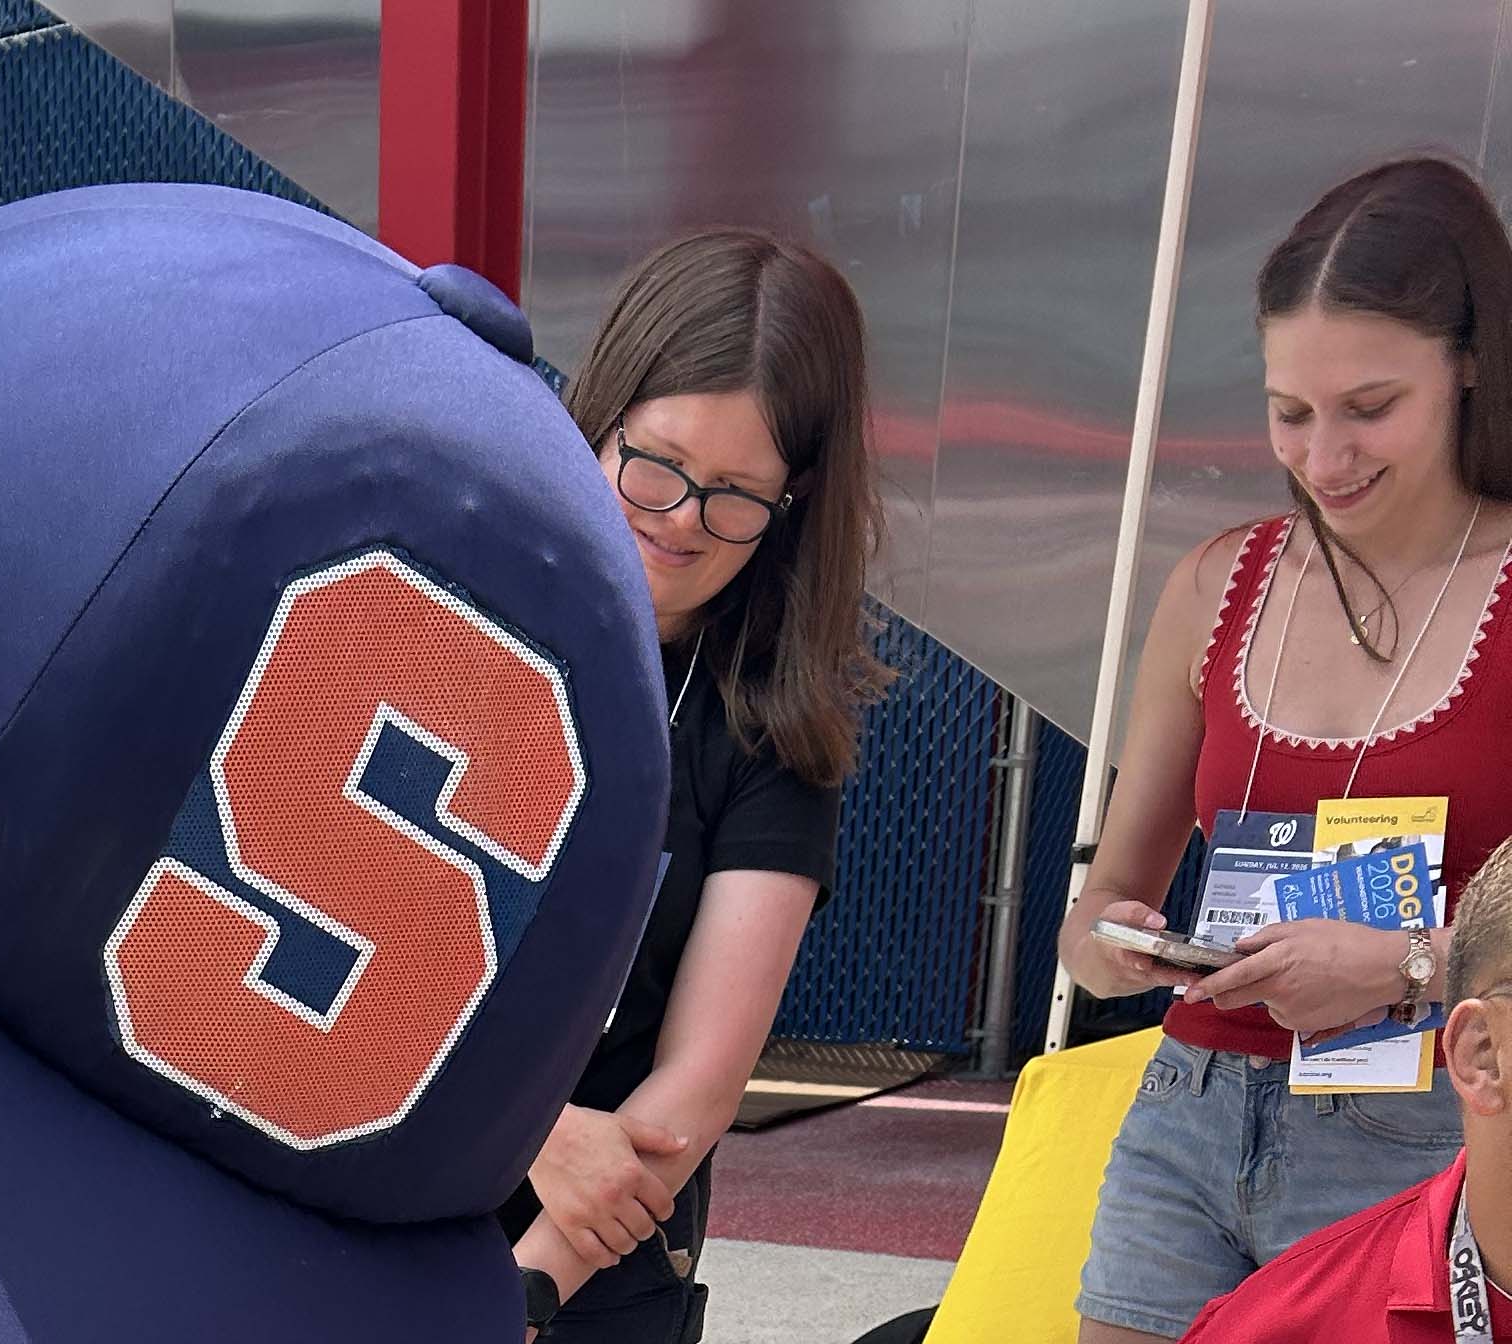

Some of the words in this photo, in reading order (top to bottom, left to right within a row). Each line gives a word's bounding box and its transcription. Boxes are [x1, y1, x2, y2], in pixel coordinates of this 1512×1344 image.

[104, 549, 587, 1152] S
[1325, 813, 1399, 826] Volunteering
[1367, 859, 1397, 919] 2026
[1452, 1247, 1490, 1332] OAKLEY
